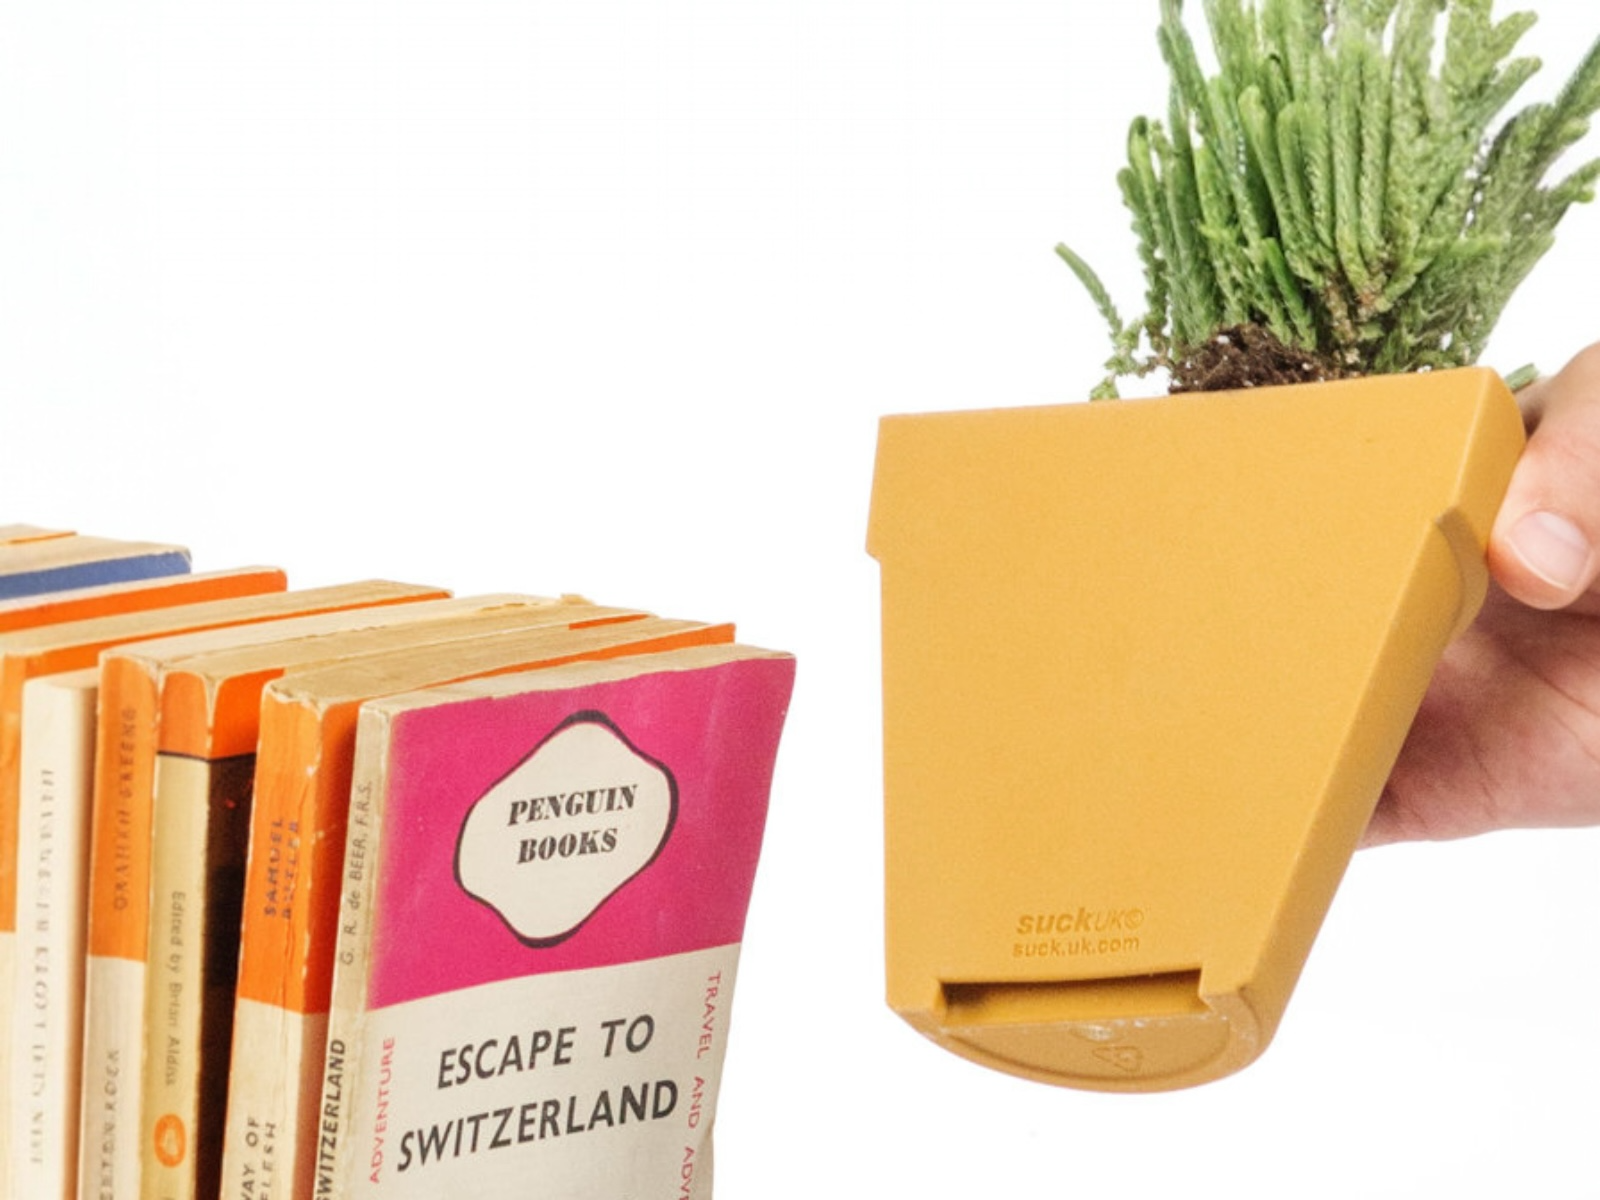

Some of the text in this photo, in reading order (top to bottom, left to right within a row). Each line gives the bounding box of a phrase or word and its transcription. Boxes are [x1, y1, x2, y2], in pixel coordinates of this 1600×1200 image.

[507, 784, 638, 827] PENGUIN
[264, 818, 284, 917] SAMUEL
[516, 829, 619, 865] BOOKS
[349, 891, 361, 911] de
[1012, 938, 1140, 958] suck.uk.com
[165, 890, 187, 1087] Edited by Brian Aldiss
[696, 971, 722, 1059] TRAVEL
[437, 1014, 656, 1090] ESCAPE TO
[245, 1117, 260, 1148] OF
[369, 1036, 395, 1184] ADVENTURE
[398, 1079, 678, 1173] SWITZERLAND
[686, 1075, 706, 1130] AND
